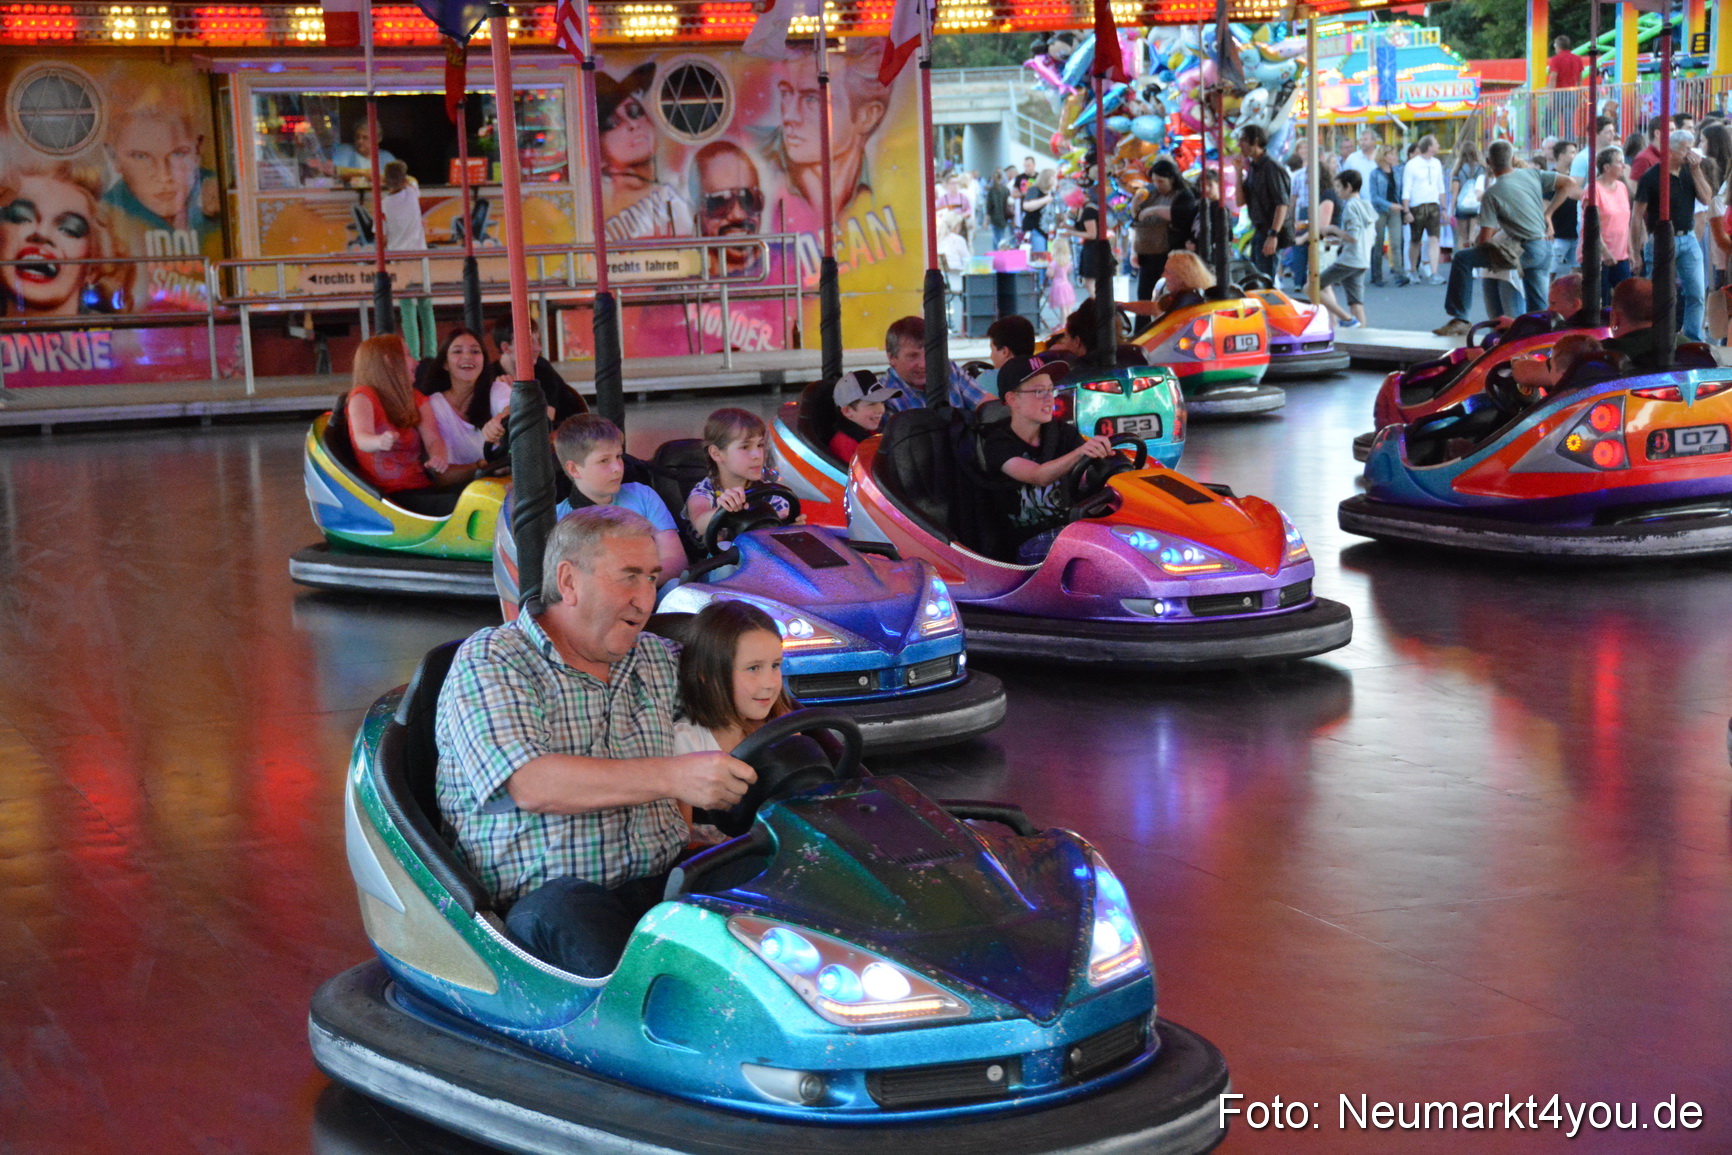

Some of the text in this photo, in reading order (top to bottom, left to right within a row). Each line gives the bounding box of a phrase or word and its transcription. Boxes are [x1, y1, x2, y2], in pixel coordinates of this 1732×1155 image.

[1397, 82, 1472, 99] TWISTER
[607, 259, 679, 273] rechts fahren
[319, 271, 355, 285] rechts
[1123, 419, 1152, 432] 23
[1683, 429, 1718, 446] 07
